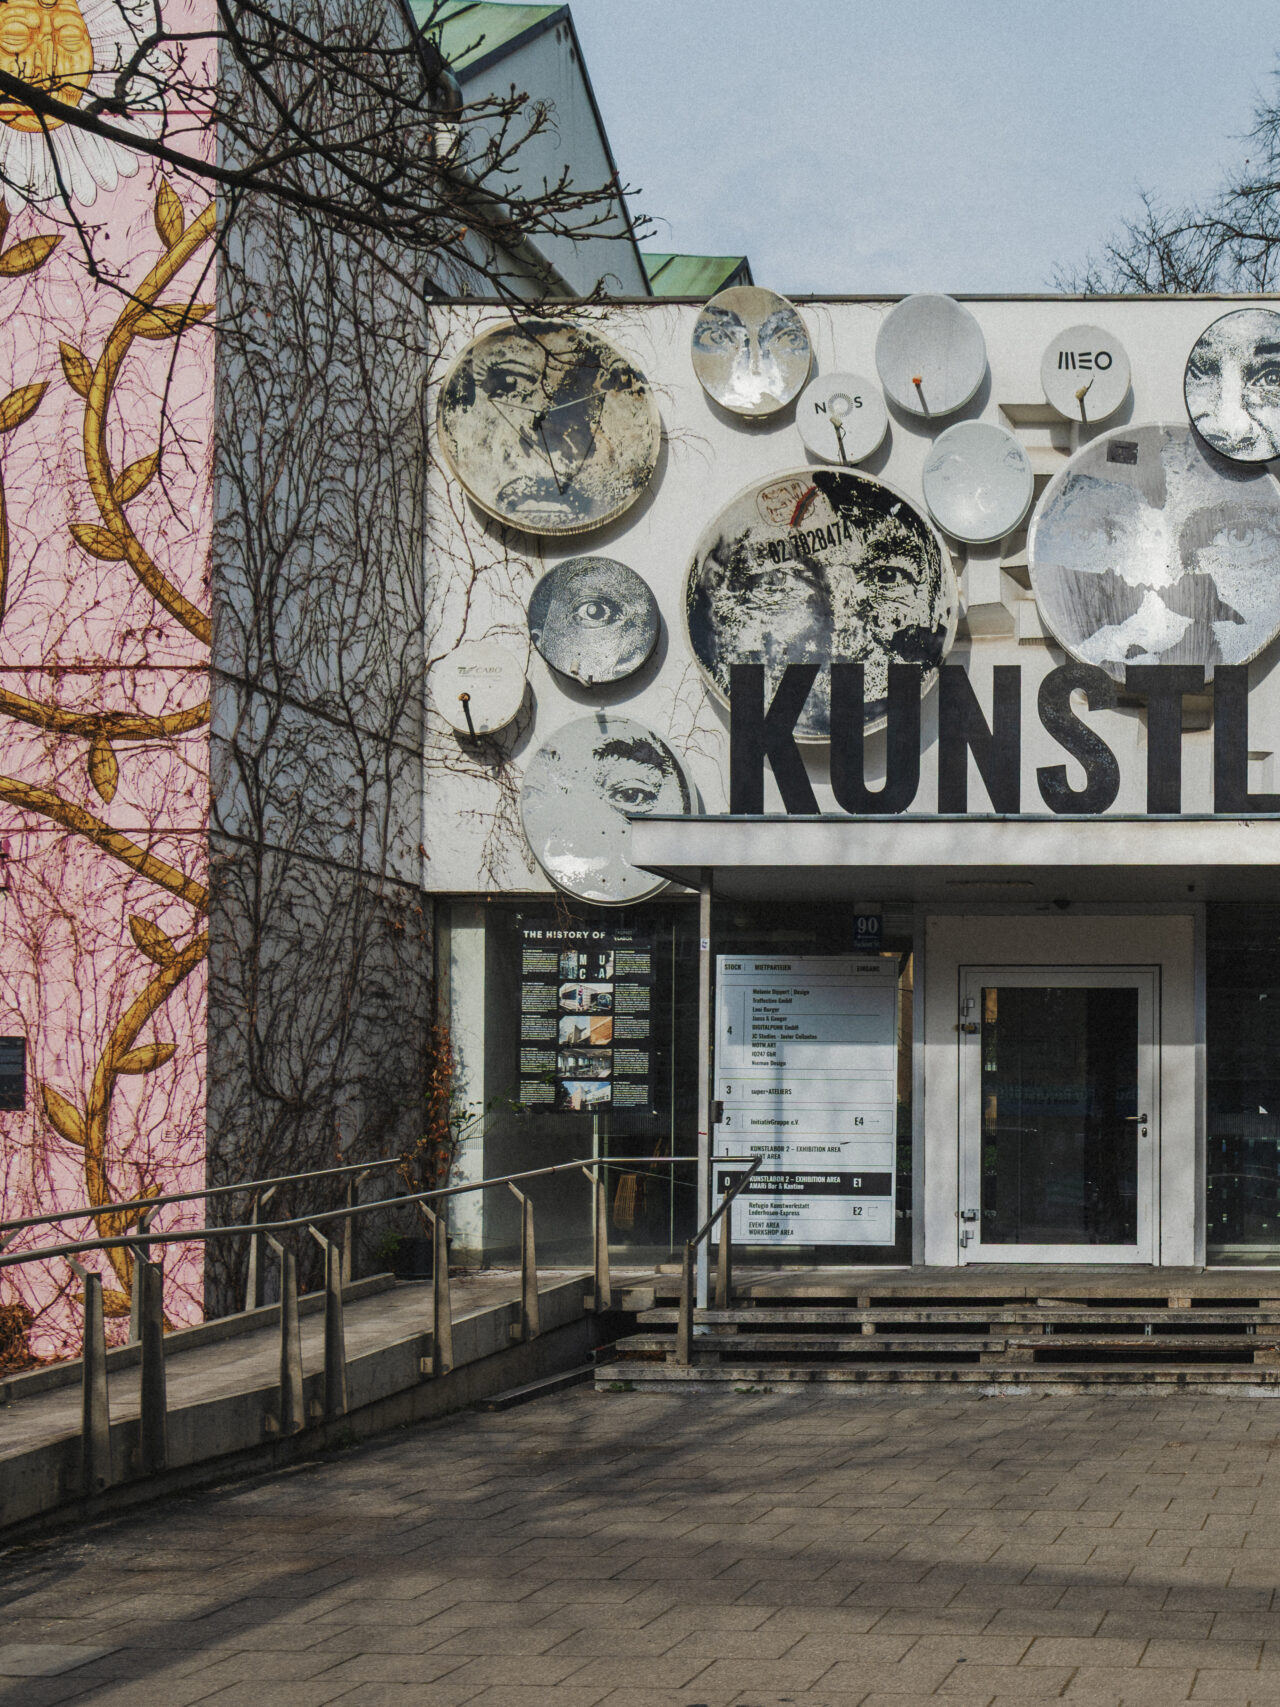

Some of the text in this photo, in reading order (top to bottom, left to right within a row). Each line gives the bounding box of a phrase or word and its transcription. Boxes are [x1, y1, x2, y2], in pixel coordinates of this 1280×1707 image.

[857, 917, 878, 934] 90
[523, 930, 543, 939] THE
[592, 931, 606, 939] OF
[727, 1026, 732, 1035] 4
[726, 1085, 732, 1094] 3
[725, 1116, 731, 1126] 2
[854, 1117, 864, 1126] E4
[725, 1148, 729, 1157] 1
[724, 1177, 730, 1186] 0
[853, 1178, 862, 1188] E1
[853, 1207, 863, 1216] E2
